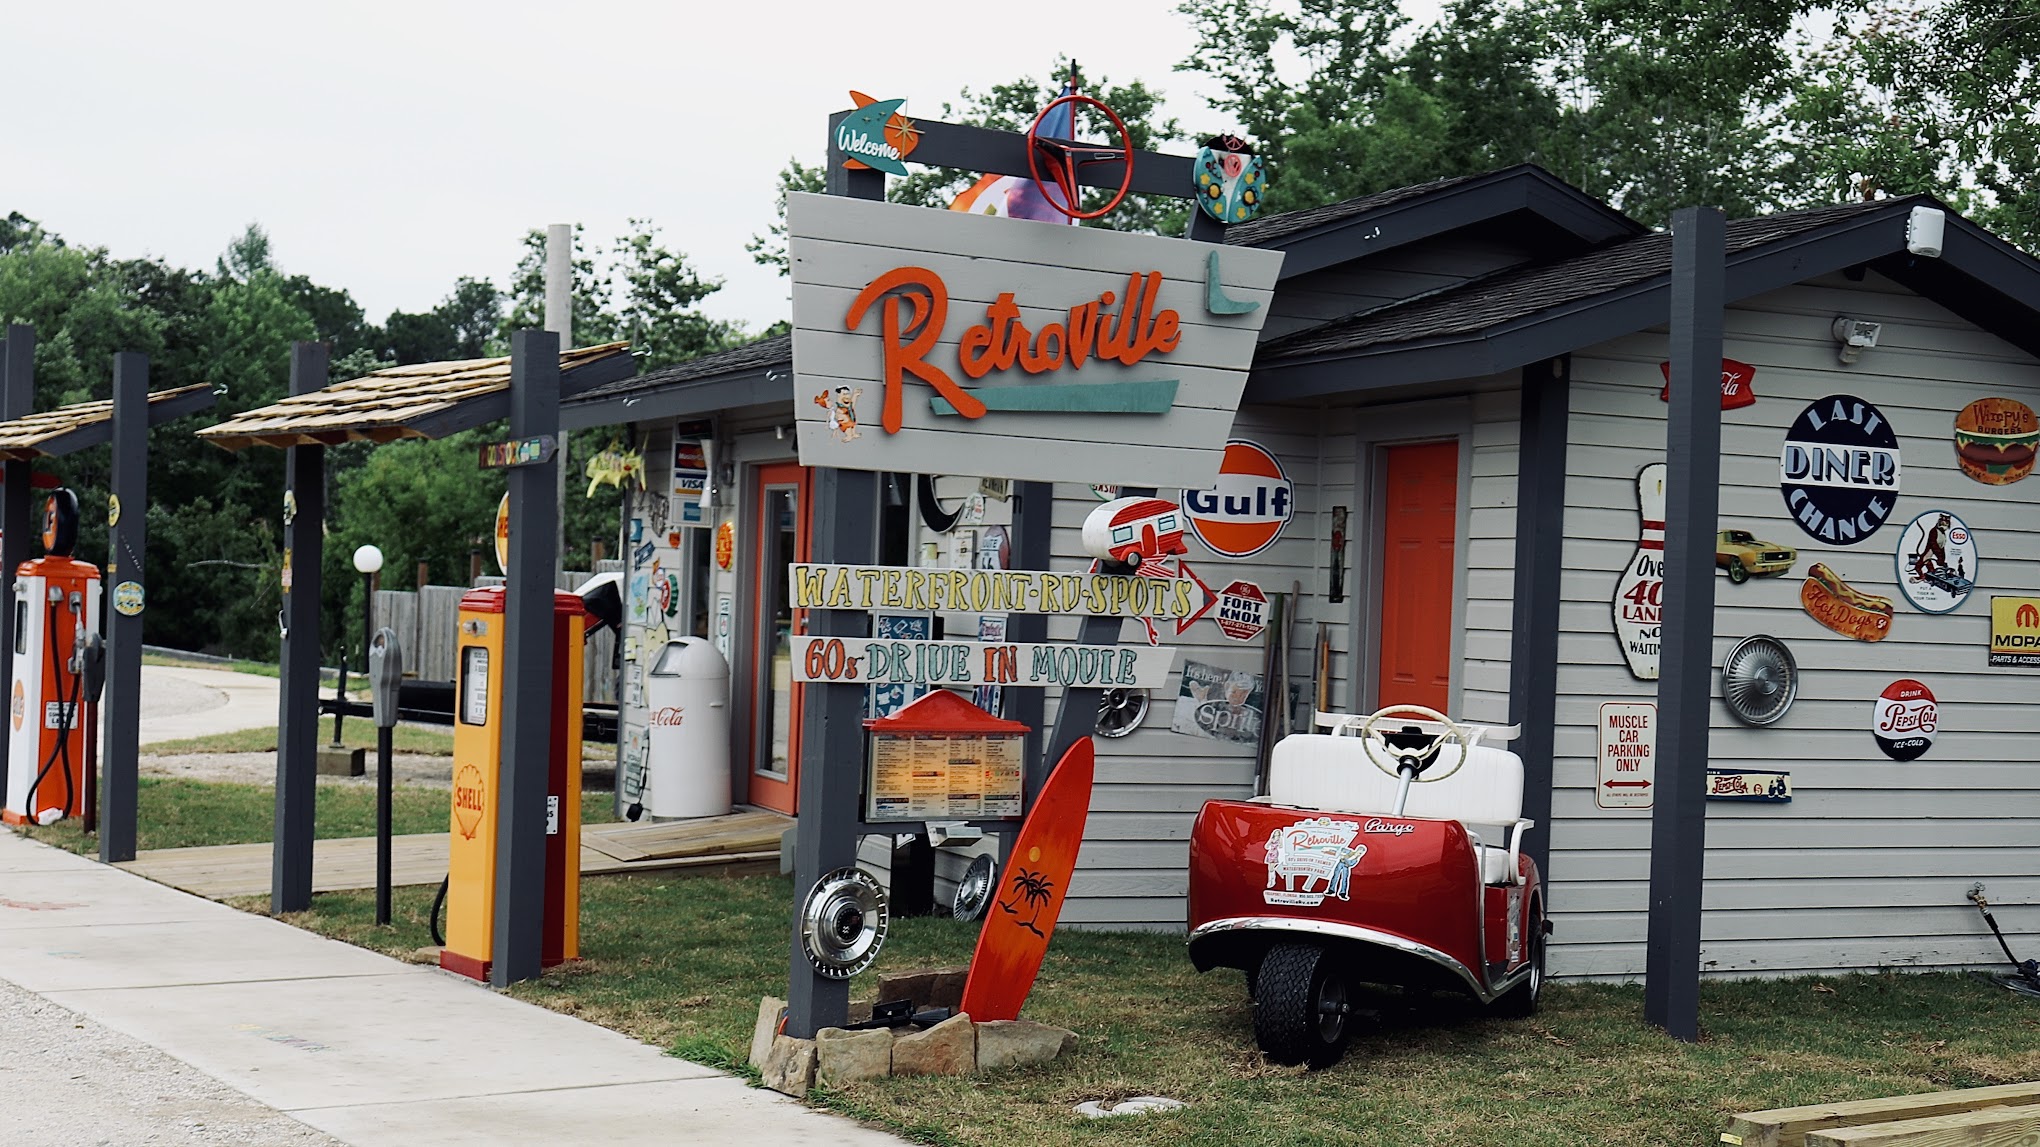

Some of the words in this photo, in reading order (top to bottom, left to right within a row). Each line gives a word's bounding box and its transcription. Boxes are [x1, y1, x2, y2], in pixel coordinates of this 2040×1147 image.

[838, 126, 900, 160] Welcome
[846, 266, 1182, 434] Retroville
[1807, 400, 1882, 435] LAST
[1978, 425, 2023, 435] BURGERS
[1785, 445, 1895, 486] DINER
[682, 479, 704, 488] VISA
[1186, 484, 1289, 517] Gulf
[1790, 489, 1888, 541] CHANCE
[1952, 531, 1966, 539] Esso
[1636, 554, 1664, 577] Ove
[1223, 596, 1262, 613] FORT
[1622, 605, 1662, 621] LAN
[1806, 584, 1835, 615] Hot
[1834, 605, 1872, 631] Dogs
[1220, 607, 1261, 625] KNOX
[1639, 626, 1661, 640] NO
[865, 642, 971, 683] DRIVE
[984, 645, 1018, 684] IN
[1030, 646, 1137, 686] MOVIE
[1992, 655, 2011, 663] PARTS
[2012, 655, 2017, 663] &
[2018, 656, 2040, 664] ACCESS
[1900, 690, 1922, 698] DRINK
[1609, 715, 1648, 728] MUSCLE
[1619, 730, 1638, 743] CAR
[1893, 739, 1924, 749] ICE-COLD
[1607, 744, 1650, 757] PARKING
[1616, 759, 1641, 772] ONLY
[457, 786, 481, 811] SHELL
[1364, 818, 1415, 835] Pargo
[1287, 830, 1346, 850] Retroville
